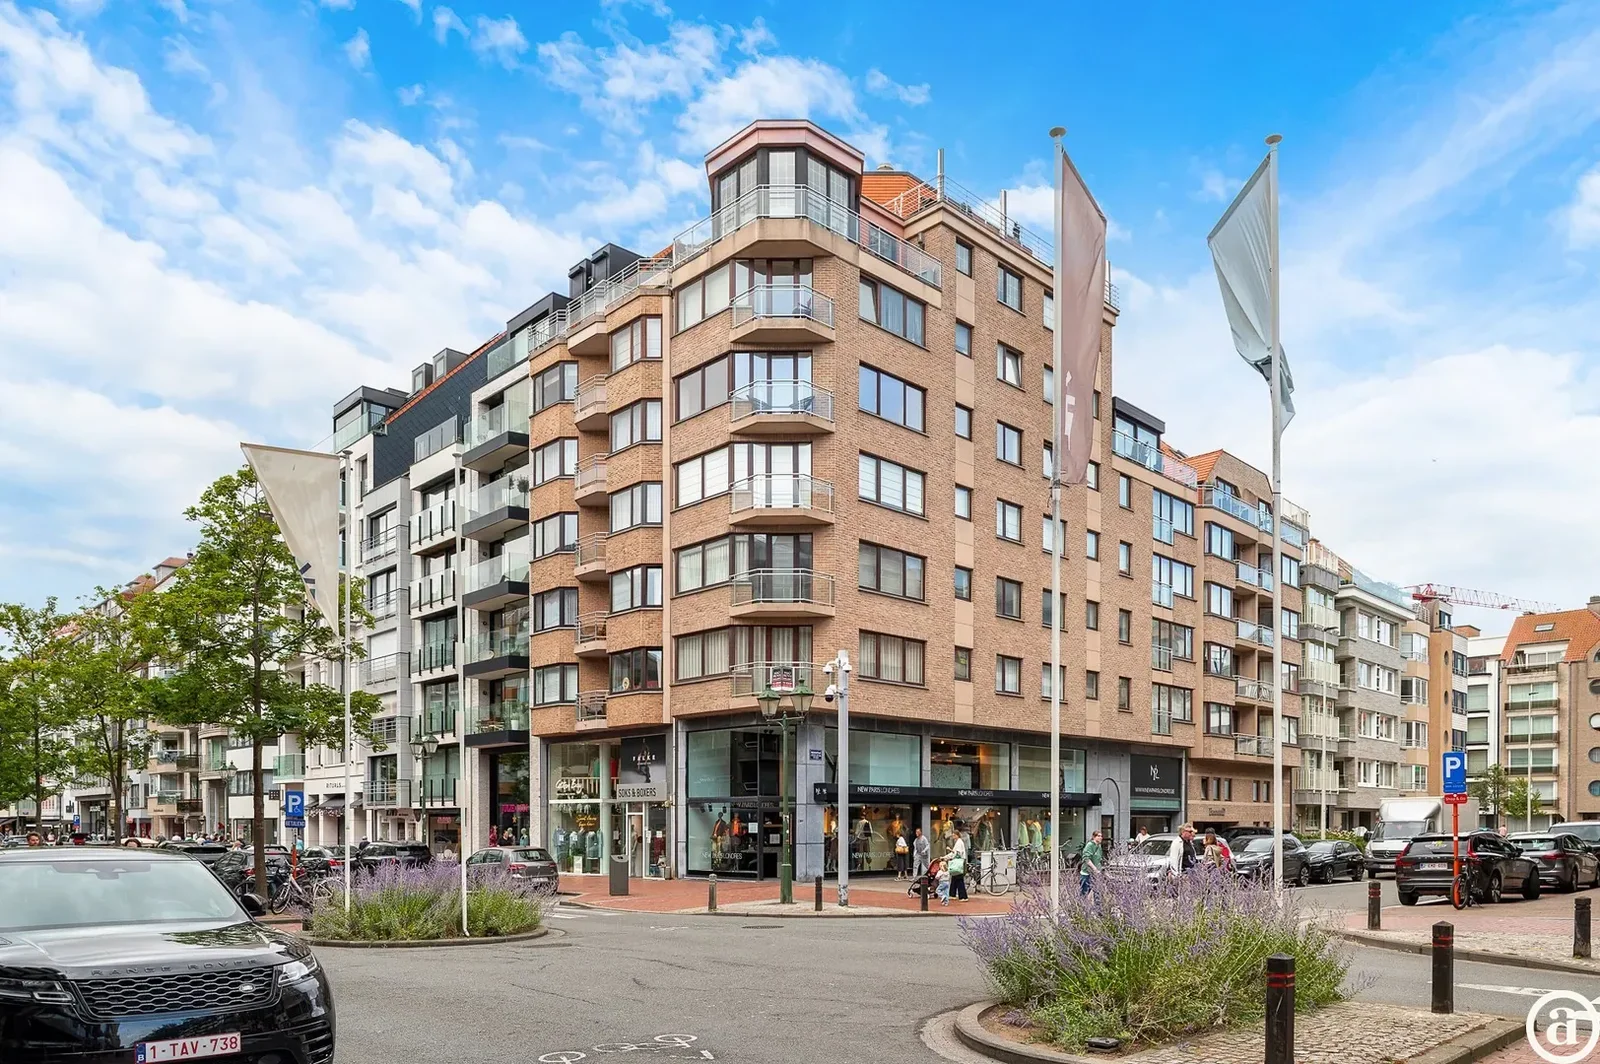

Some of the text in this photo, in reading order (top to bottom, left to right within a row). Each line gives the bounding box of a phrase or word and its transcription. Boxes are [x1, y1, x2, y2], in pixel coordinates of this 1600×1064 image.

[1445, 756, 1461, 778] P
[618, 787, 657, 798] SOKS & BOXERS
[288, 795, 302, 813] P
[91, 958, 260, 977] RANGE ROVER
[149, 1035, 239, 1060] 1-TAV-738
[136, 1054, 145, 1063] B
